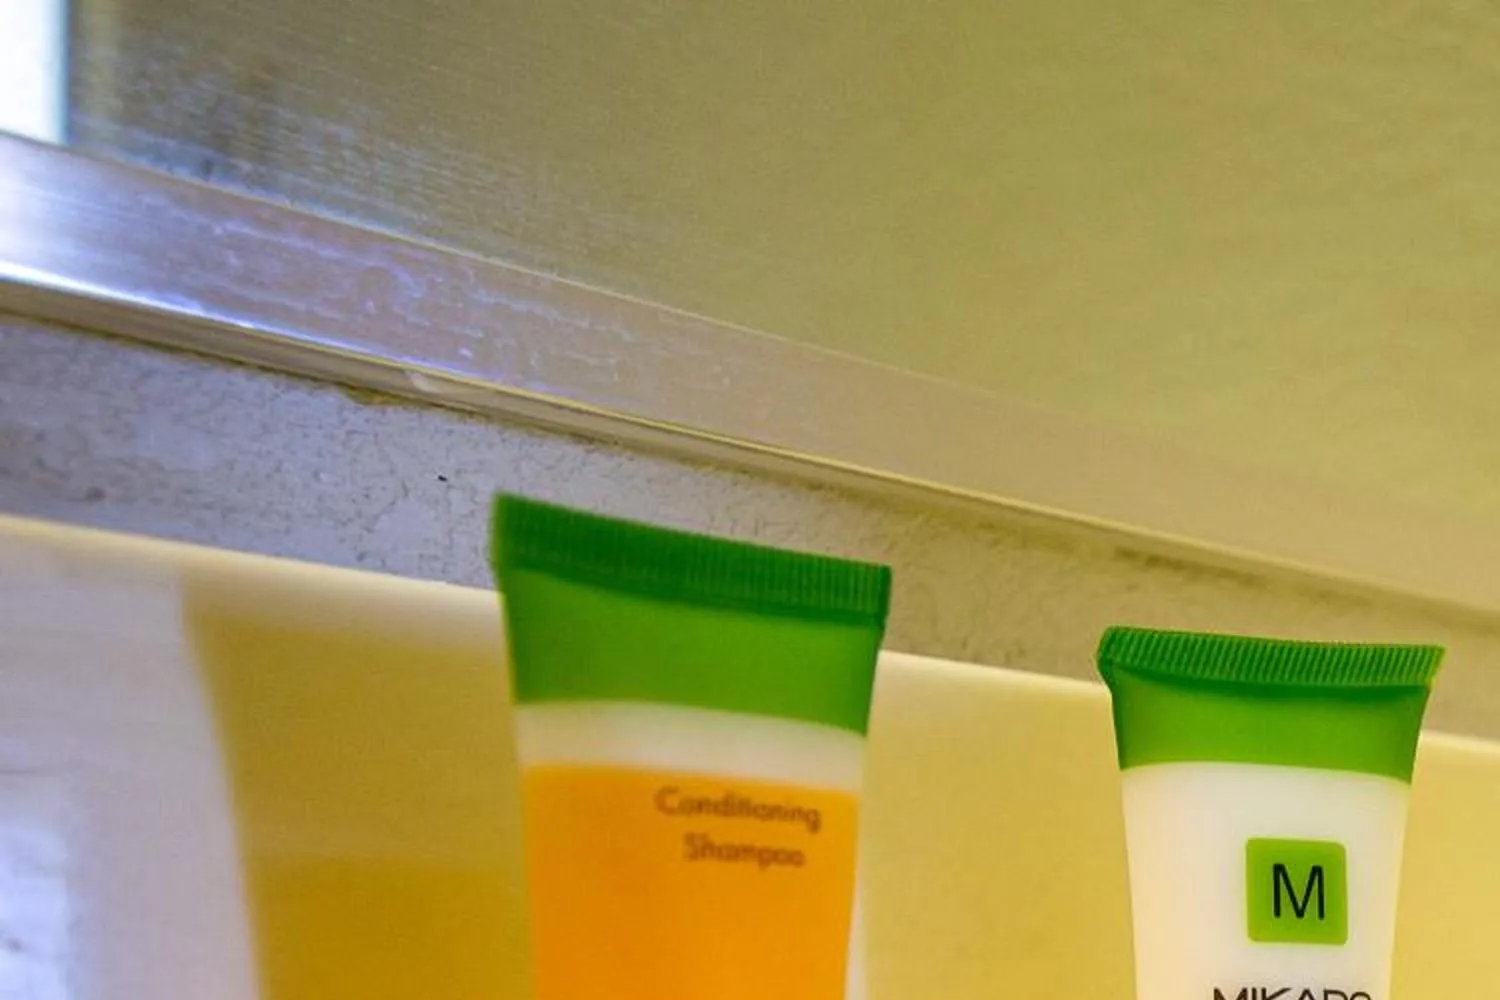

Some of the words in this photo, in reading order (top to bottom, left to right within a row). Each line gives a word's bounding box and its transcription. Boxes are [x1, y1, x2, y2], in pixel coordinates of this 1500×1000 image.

[653, 785, 822, 834] Conditioning
[683, 832, 806, 869] Shampoo
[1272, 862, 1326, 921] M
